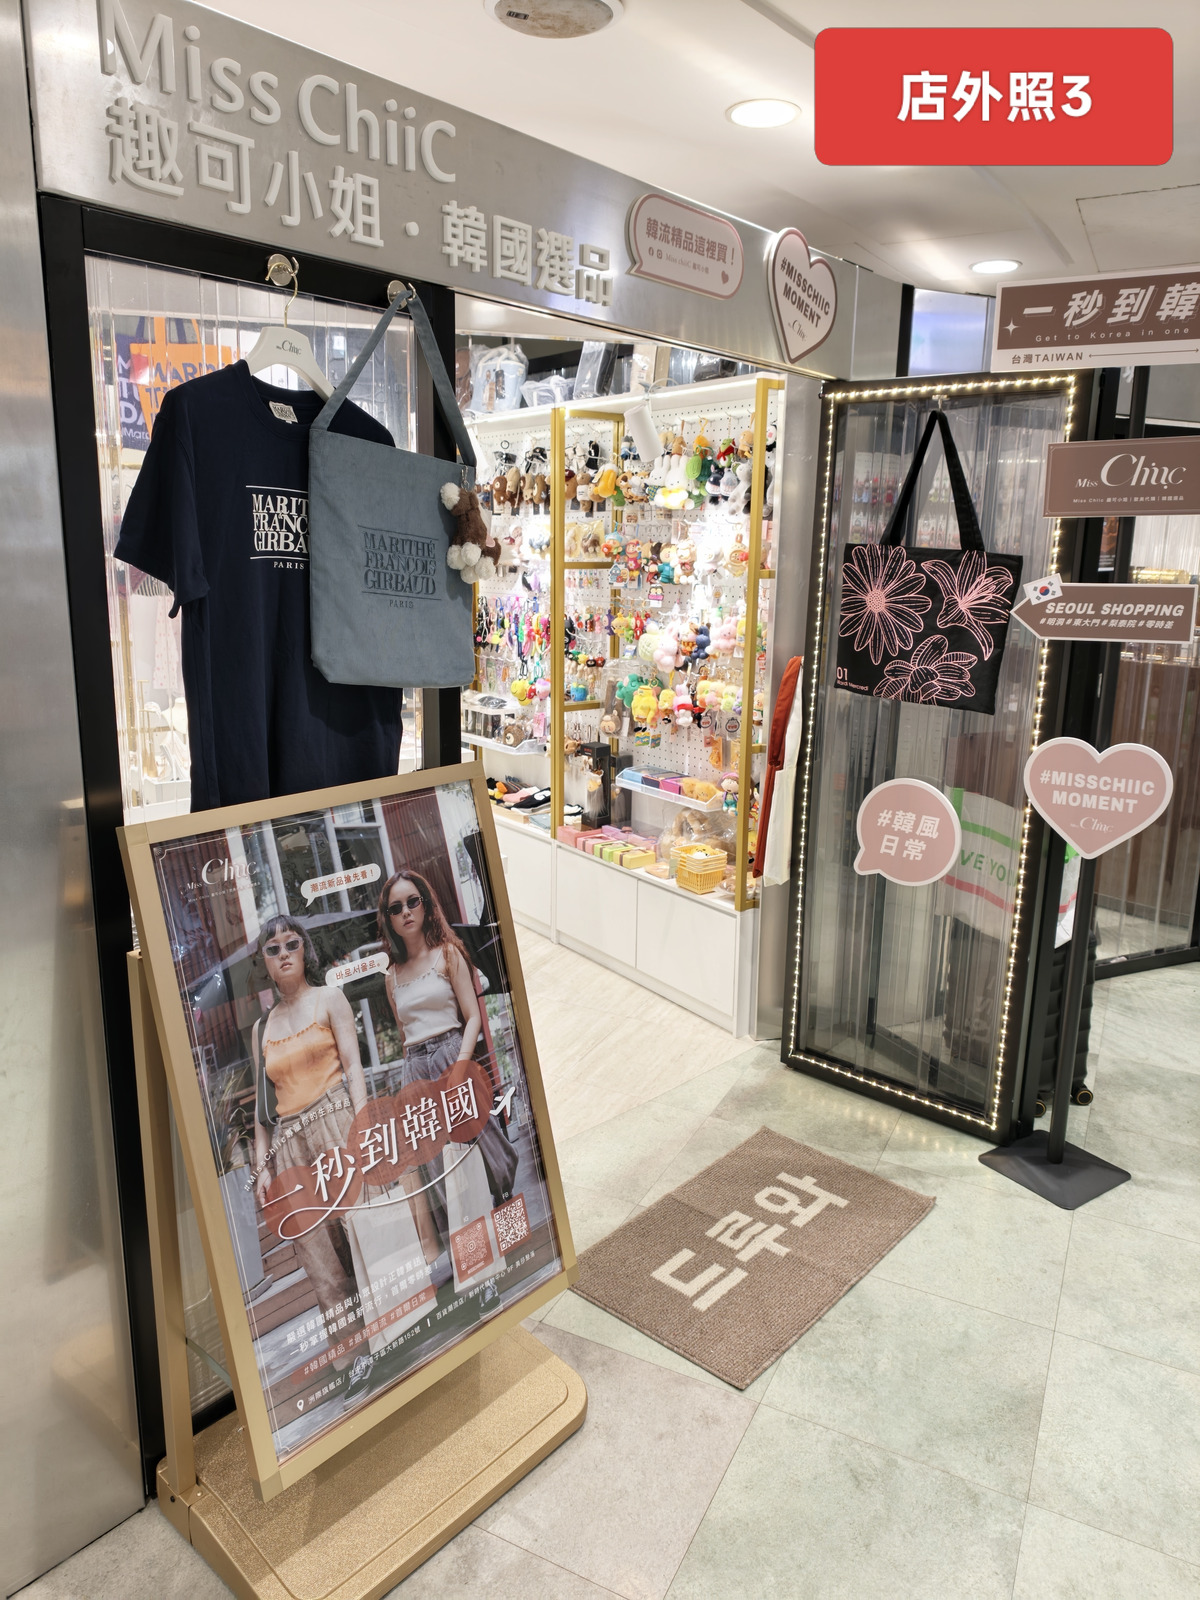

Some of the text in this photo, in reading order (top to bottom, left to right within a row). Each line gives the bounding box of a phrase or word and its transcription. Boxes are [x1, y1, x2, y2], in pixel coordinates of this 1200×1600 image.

[101, 0, 457, 183] Miss ChiiC
[646, 217, 734, 265] 韓流精品這裡買！
[780, 256, 830, 315] #MISSCHIIC
[783, 282, 821, 328] MOMENT
[1036, 334, 1057, 342] Get
[1090, 330, 1131, 339] Korea
[1141, 328, 1153, 336] in
[1165, 327, 1189, 335] one
[1075, 478, 1098, 489] Miss
[254, 531, 310, 554] GIRBA
[273, 561, 305, 570] PARIS
[364, 569, 436, 595] GIRBAUD
[389, 599, 414, 608] PARIS
[1045, 602, 1184, 616] SEOUL SHOPPING
[837, 666, 848, 680] 01
[1039, 769, 1155, 796] #MISSCHIIC
[1052, 790, 1138, 814] MOMENT
[877, 809, 940, 839] #韓風
[879, 835, 927, 862] 日常
[310, 869, 375, 893] 潮流新品搶先看！
[261, 1077, 479, 1212] 一秒到韓國
[303, 1291, 427, 1376] #韓國精品 #最新潮流 #首爾日常
